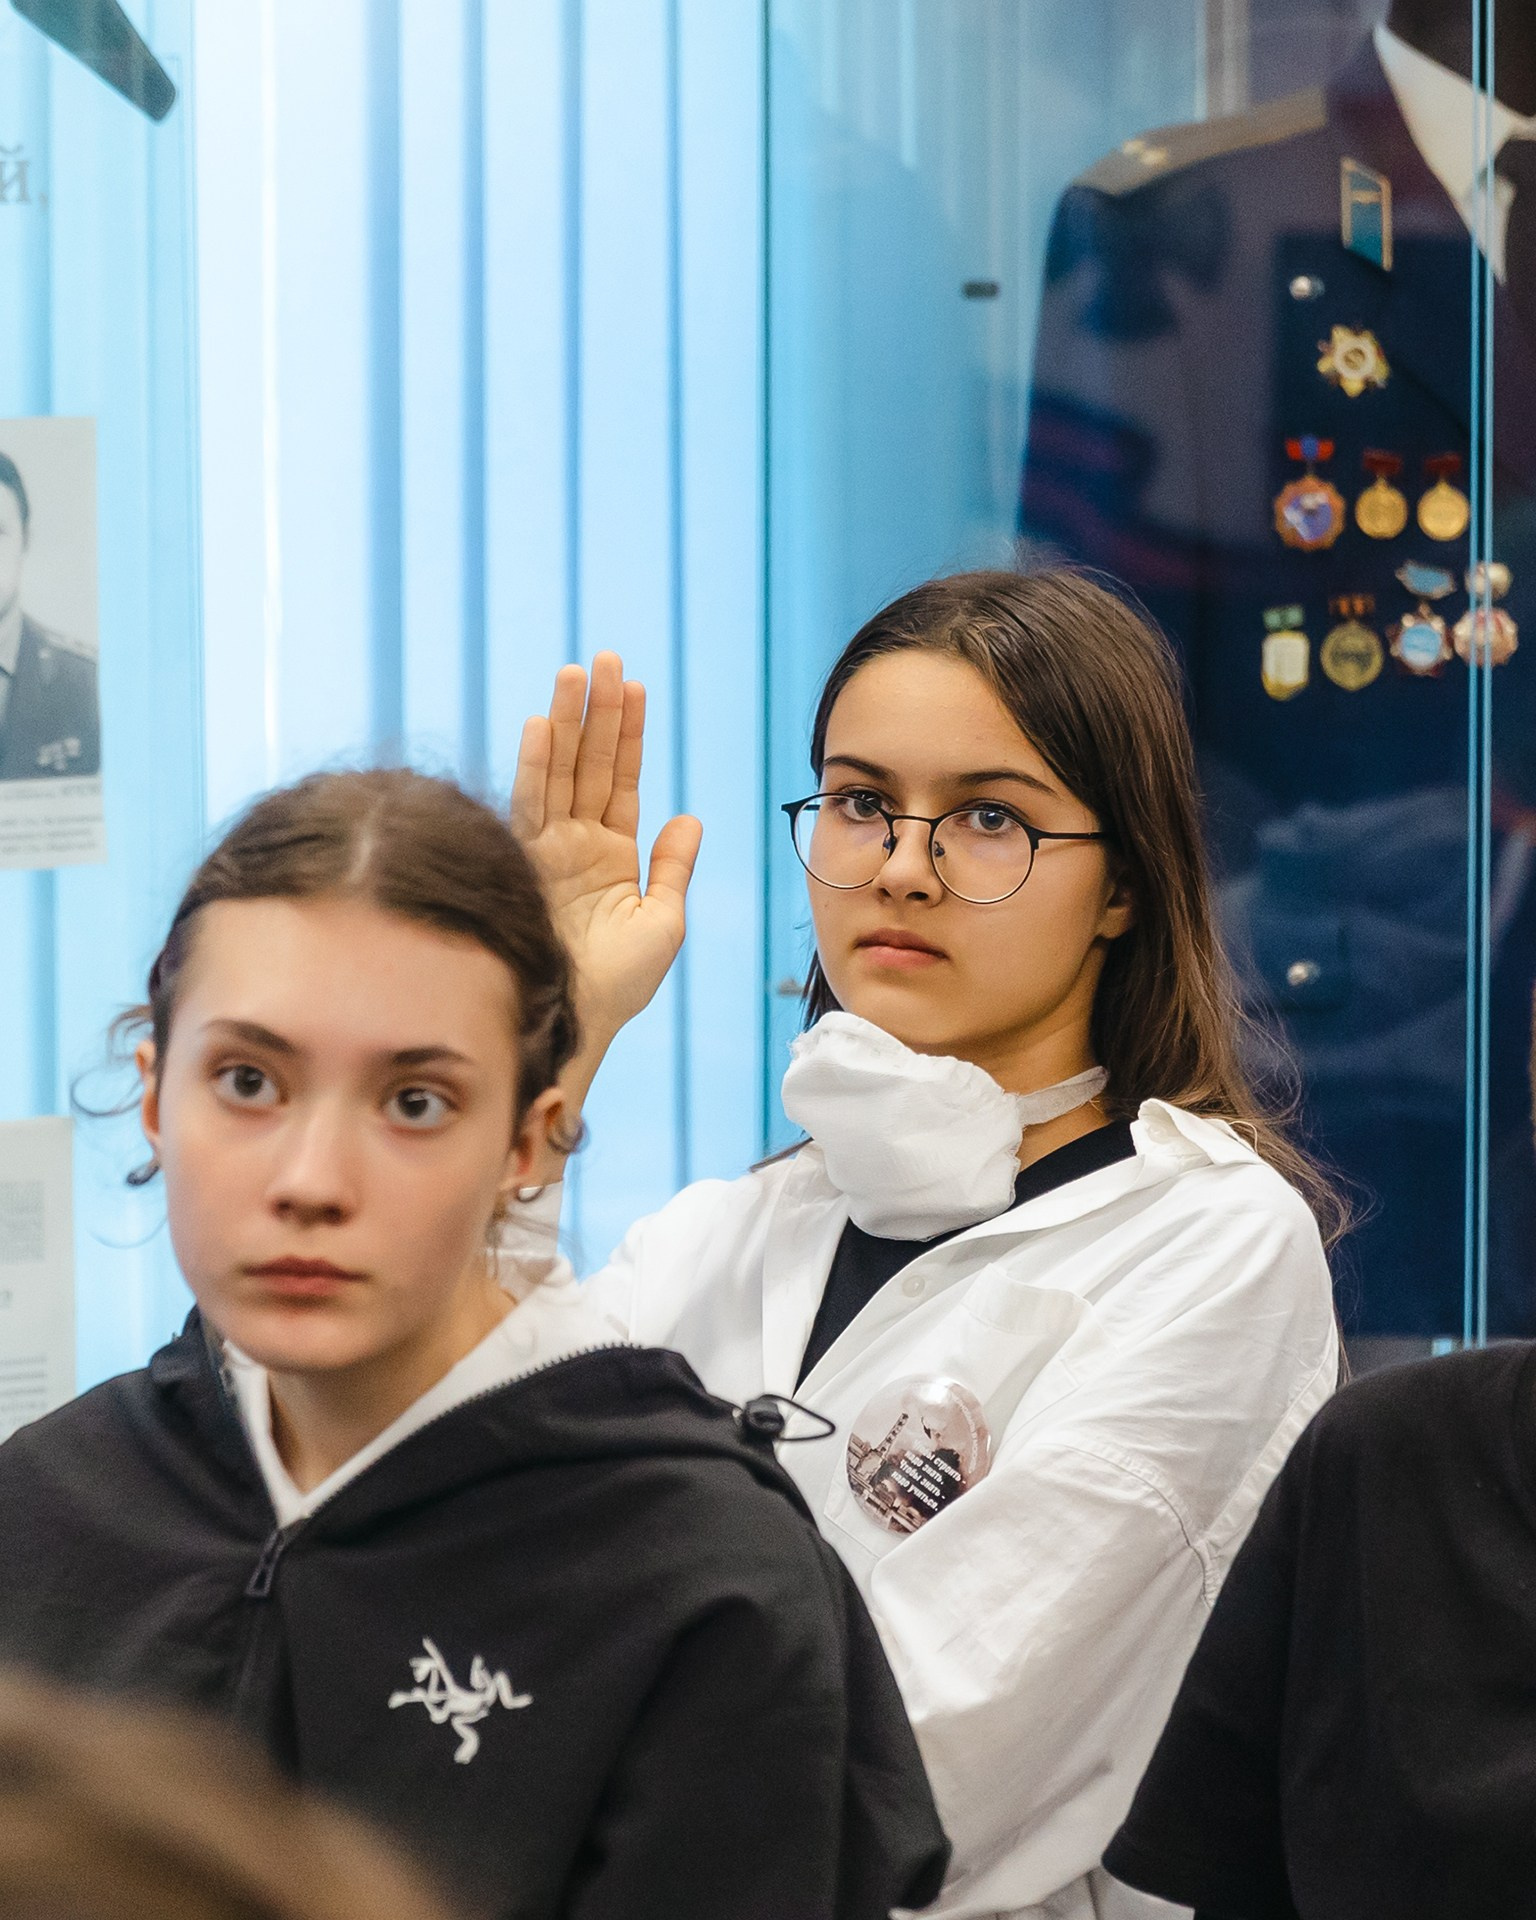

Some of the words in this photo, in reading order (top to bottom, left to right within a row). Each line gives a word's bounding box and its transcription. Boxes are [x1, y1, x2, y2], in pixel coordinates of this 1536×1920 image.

[904, 1450, 924, 1467] надо
[933, 1457, 962, 1482] строить
[891, 1471, 910, 1488] надо
[907, 1484, 938, 1511] учиться.
[899, 1459, 922, 1481] Чтобы
[920, 1478, 941, 1497] знать
